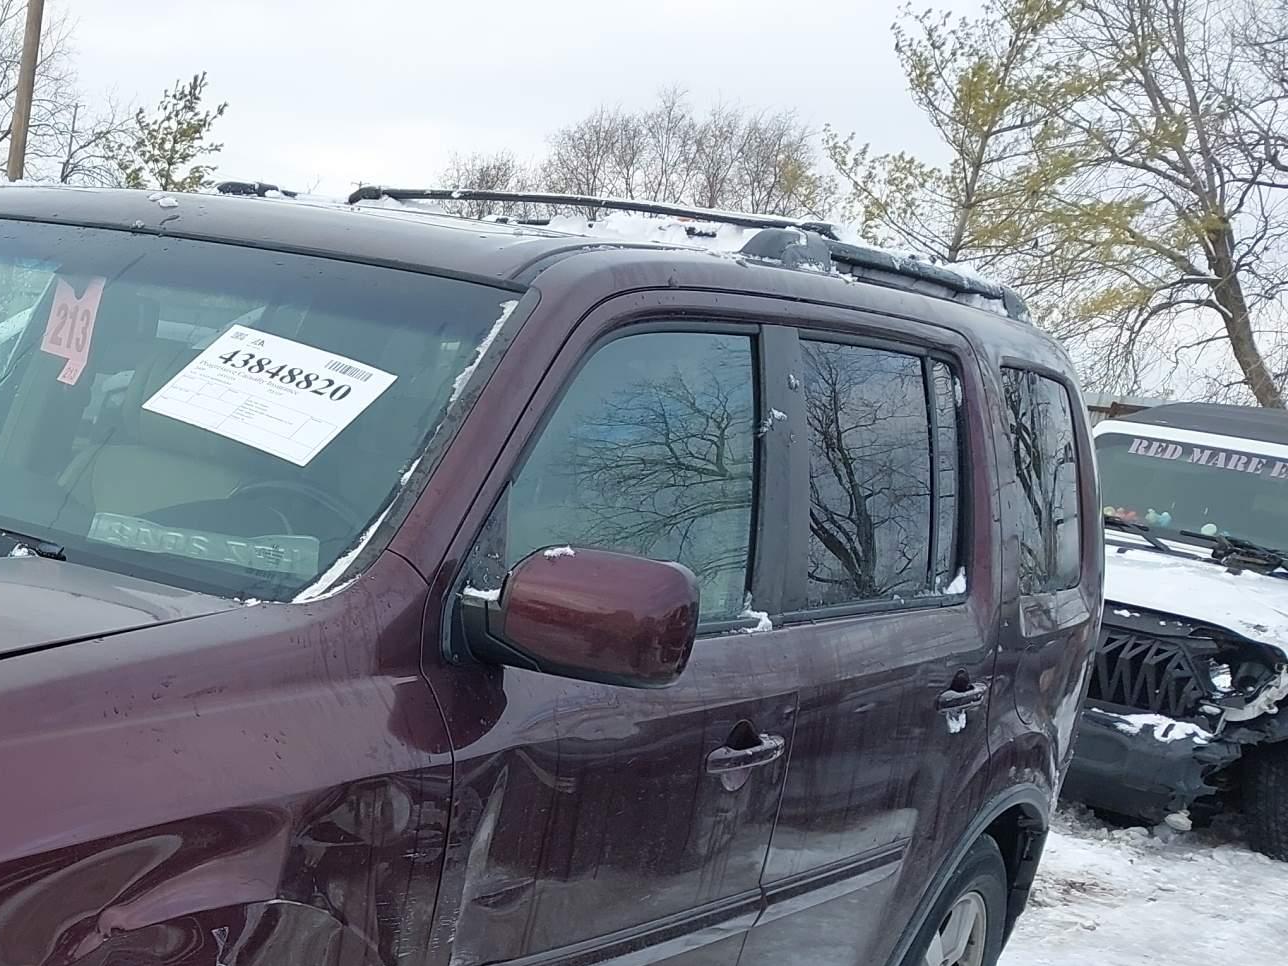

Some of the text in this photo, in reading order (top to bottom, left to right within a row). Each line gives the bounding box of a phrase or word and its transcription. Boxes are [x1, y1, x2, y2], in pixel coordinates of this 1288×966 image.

[49, 303, 91, 353] 213
[218, 348, 352, 402] 43848820
[1128, 438, 1183, 460] RED
[1188, 447, 1267, 474] MARE
